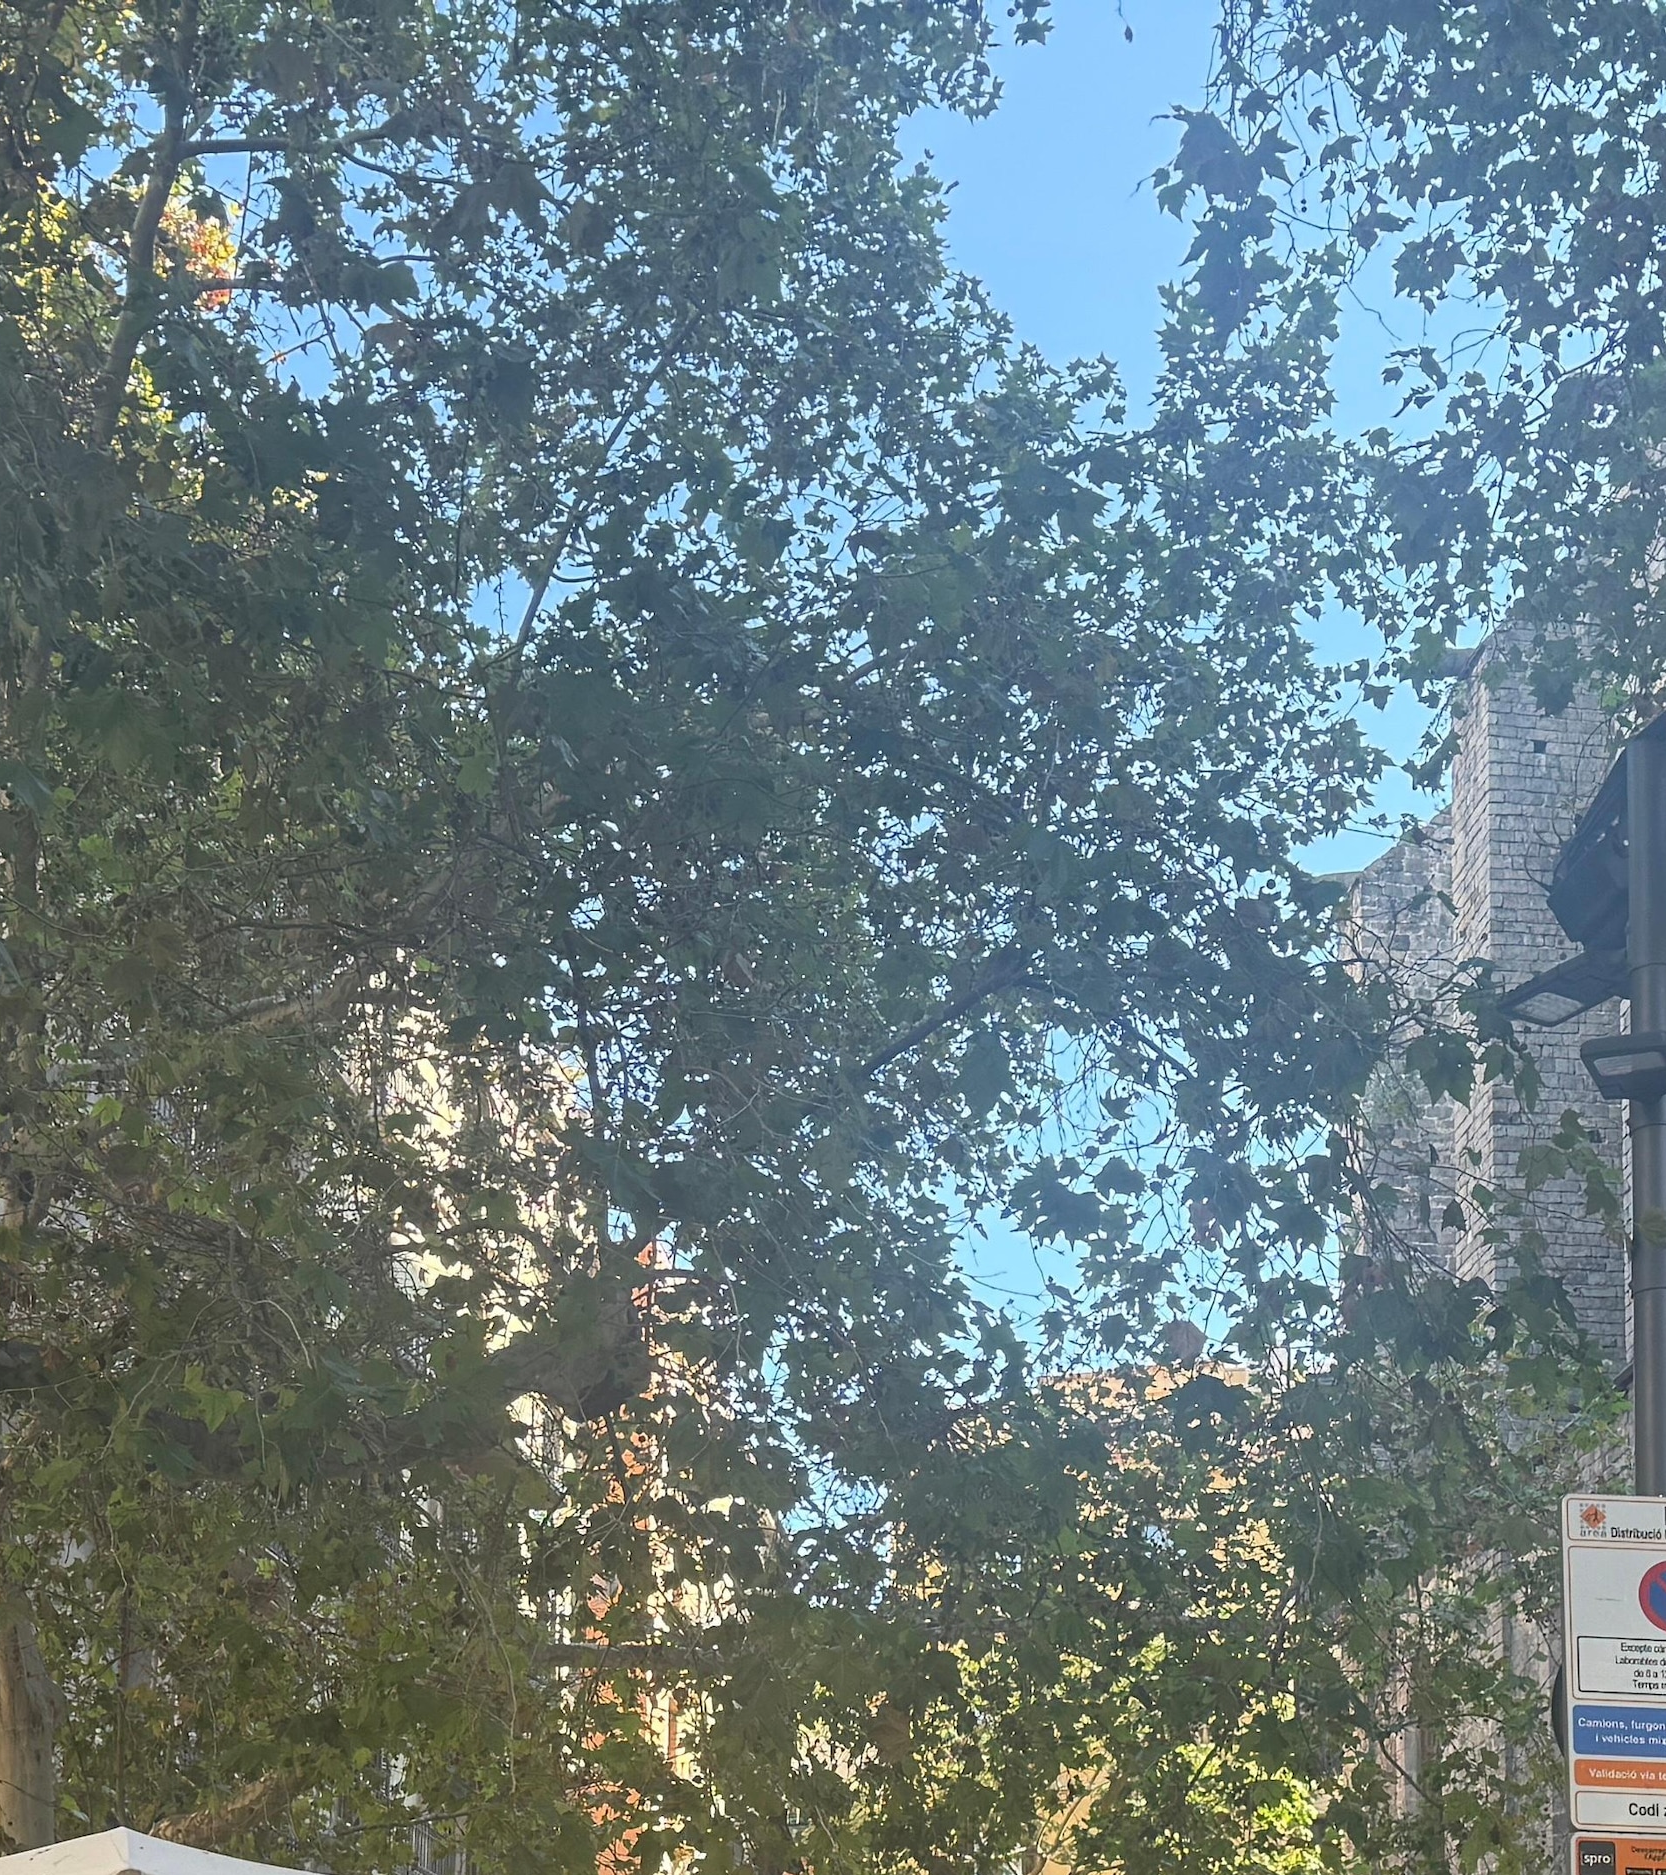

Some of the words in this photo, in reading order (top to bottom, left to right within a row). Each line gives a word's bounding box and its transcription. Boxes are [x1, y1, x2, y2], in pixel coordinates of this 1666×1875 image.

[1610, 1526, 1662, 1541] Distribució
[1578, 1716, 1628, 1731] Camions,
[1601, 1733, 1646, 1745] vehicles
[1588, 1767, 1637, 1780] Validació
[1639, 1770, 1655, 1781] via
[1628, 1802, 1660, 1817] Codi
[1583, 1851, 1611, 1866] spro
